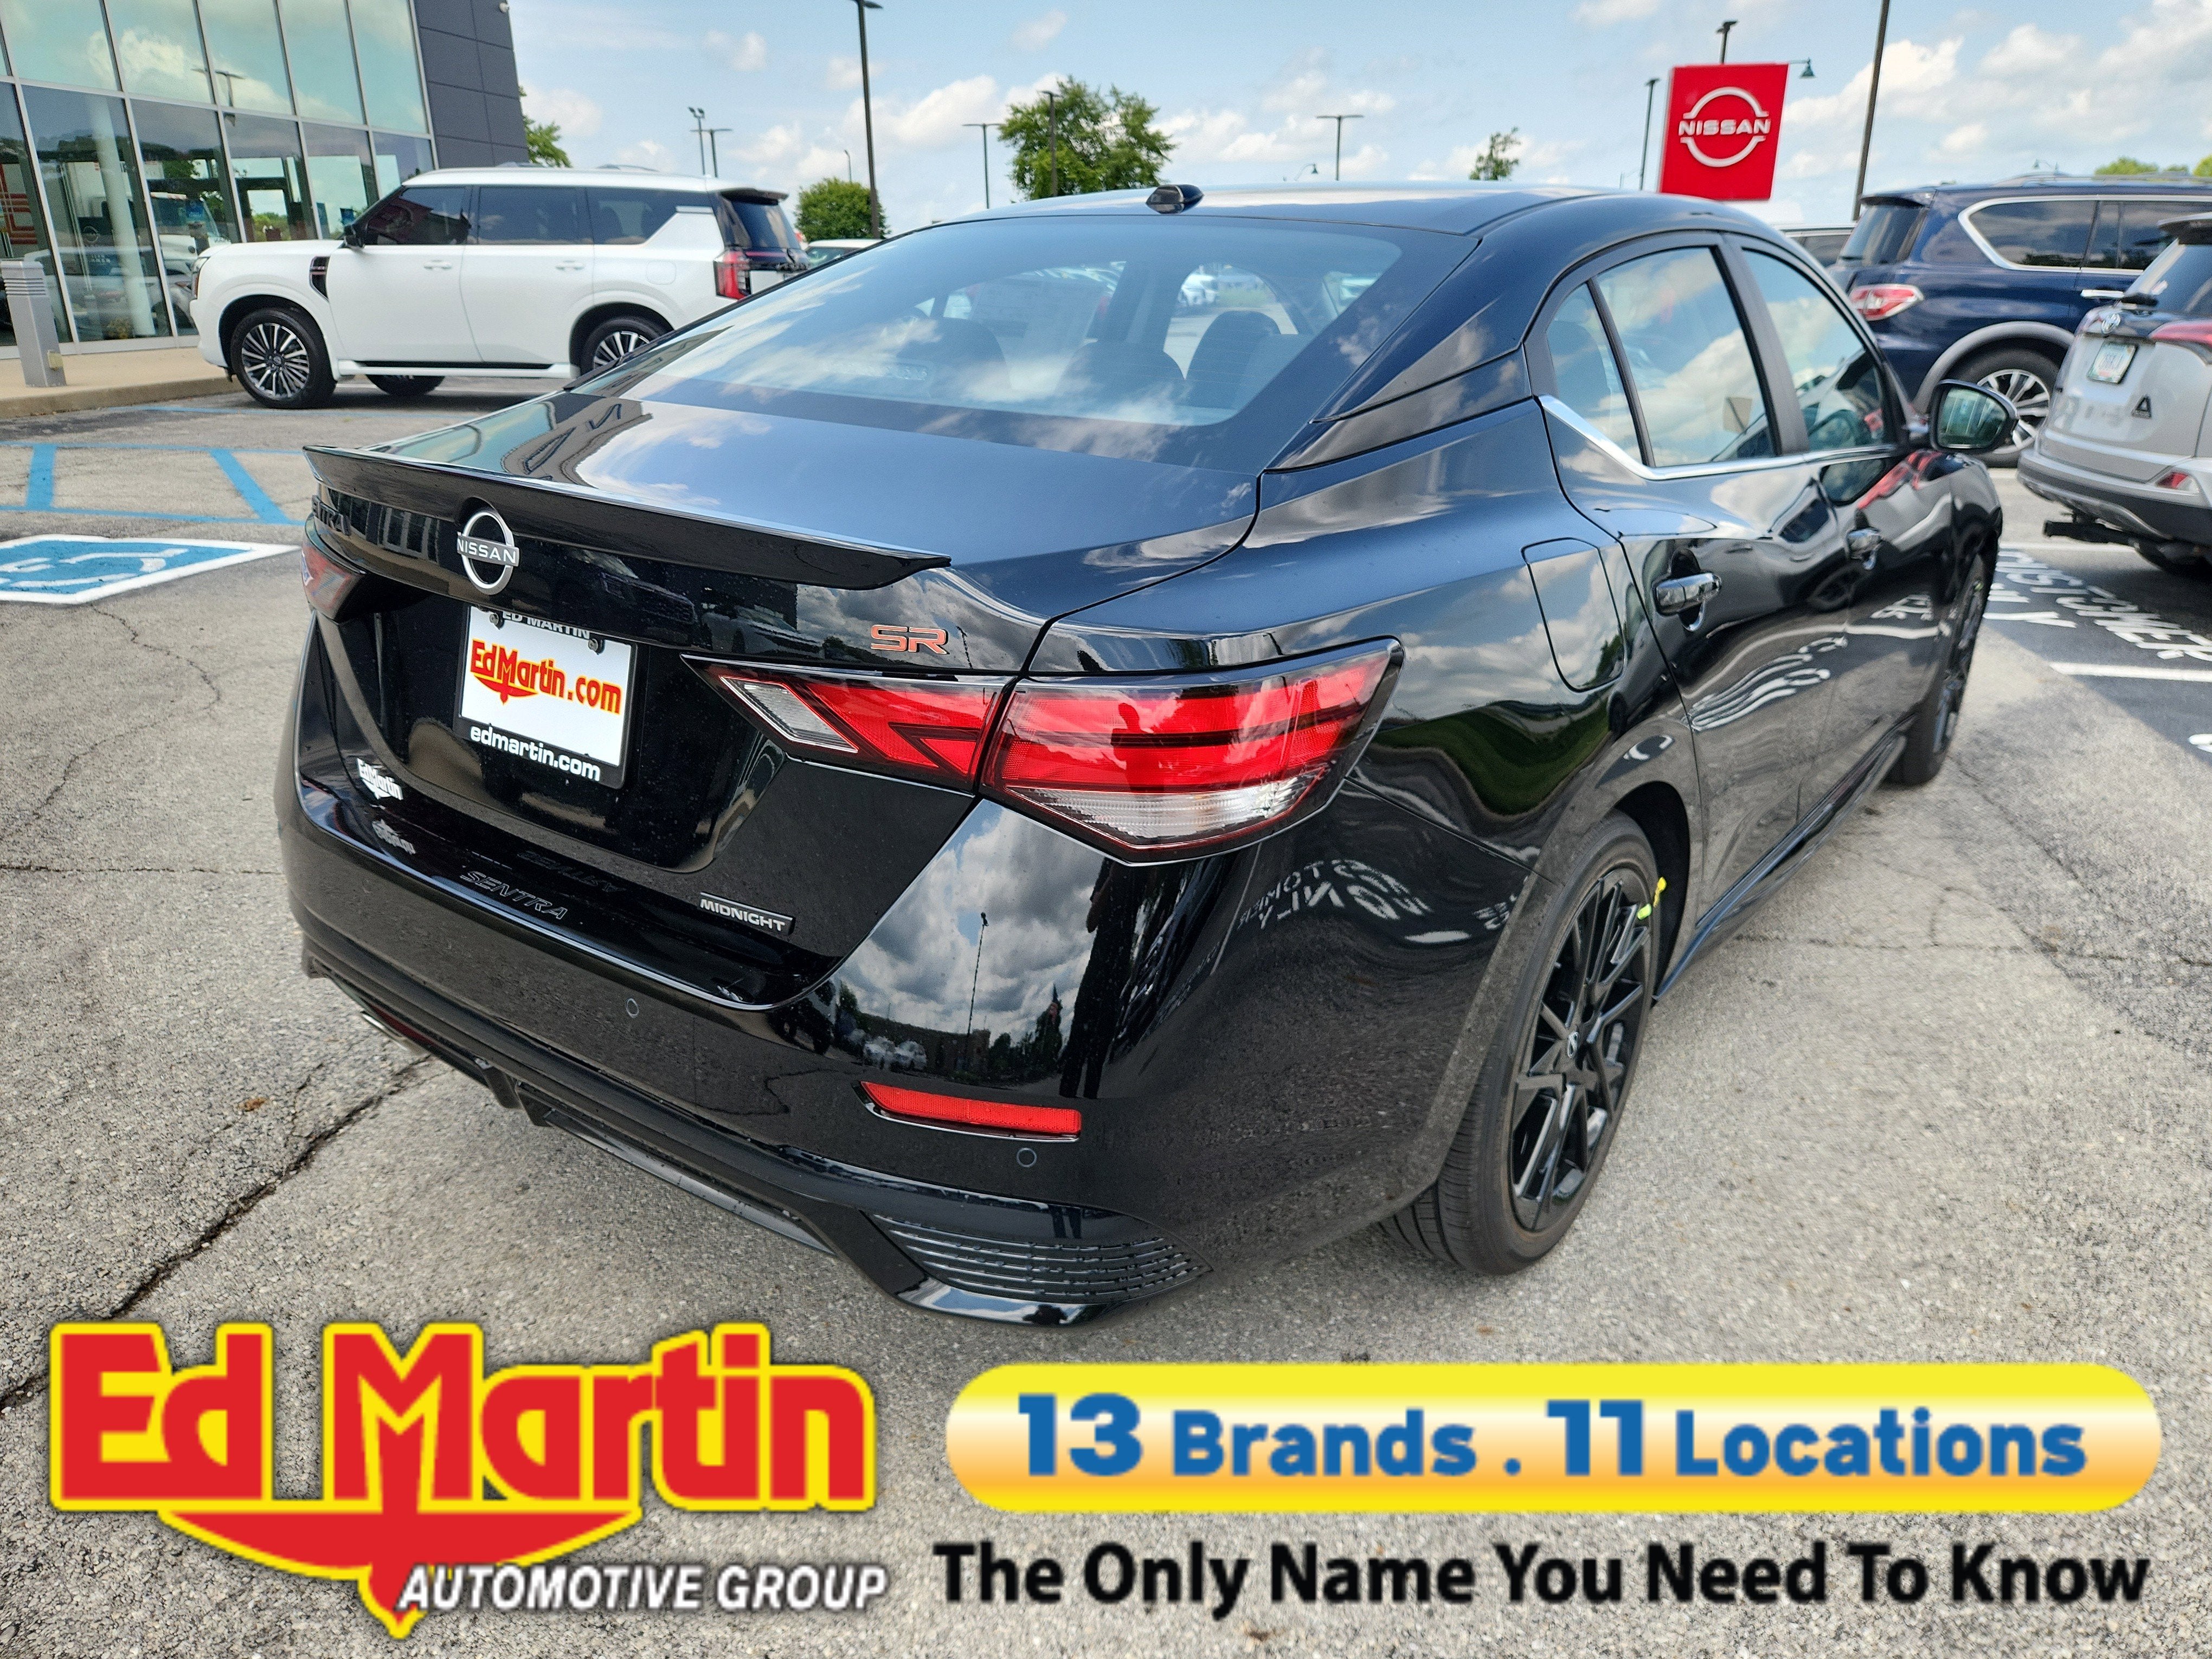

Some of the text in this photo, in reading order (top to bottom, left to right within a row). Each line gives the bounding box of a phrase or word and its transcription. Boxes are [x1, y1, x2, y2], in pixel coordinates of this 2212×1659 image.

[1679, 119, 1771, 136] NISSAN
[456, 538, 516, 564] NISSAN
[502, 610, 590, 640] ED MARTIN
[871, 624, 948, 654] SR
[470, 726, 600, 781] edmartin.com
[460, 870, 568, 920] SENTRA
[700, 898, 786, 932] MIDNIGHT
